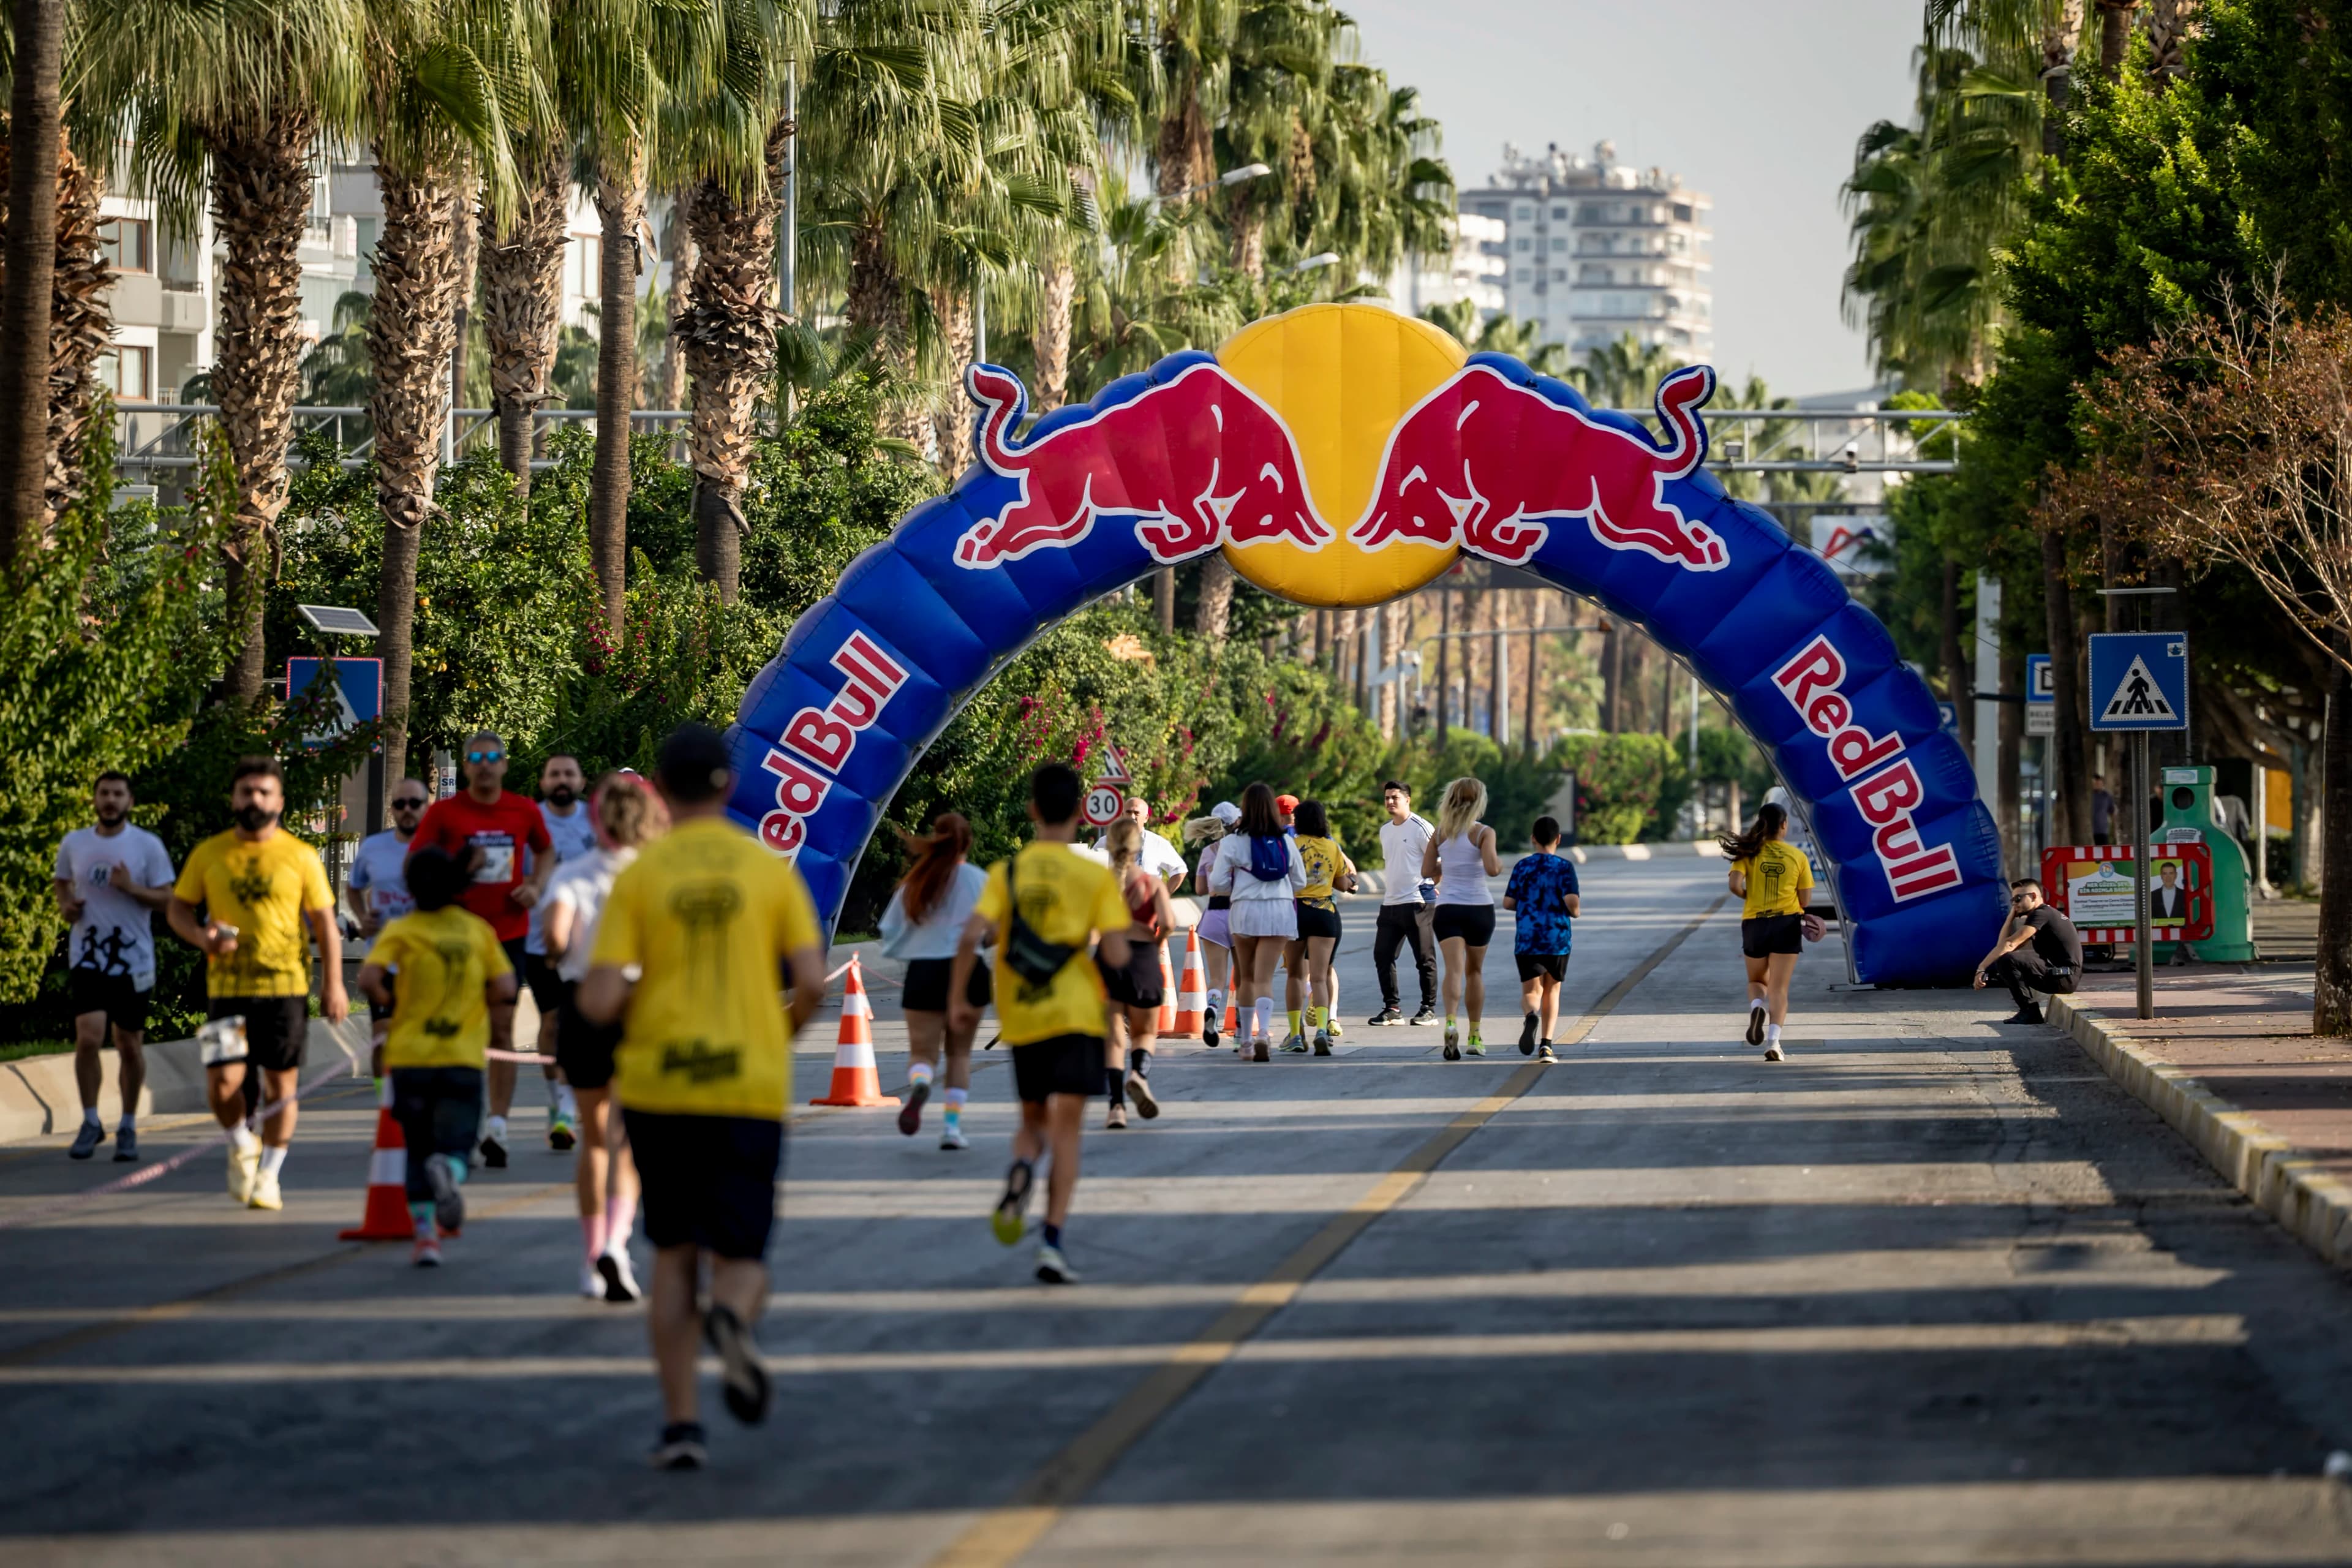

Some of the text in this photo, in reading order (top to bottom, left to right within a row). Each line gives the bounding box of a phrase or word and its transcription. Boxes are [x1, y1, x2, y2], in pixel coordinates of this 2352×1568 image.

[760, 631, 907, 859] ed Bull
[1090, 795, 1115, 815] 30
[1774, 636, 1961, 900] Red Bull
